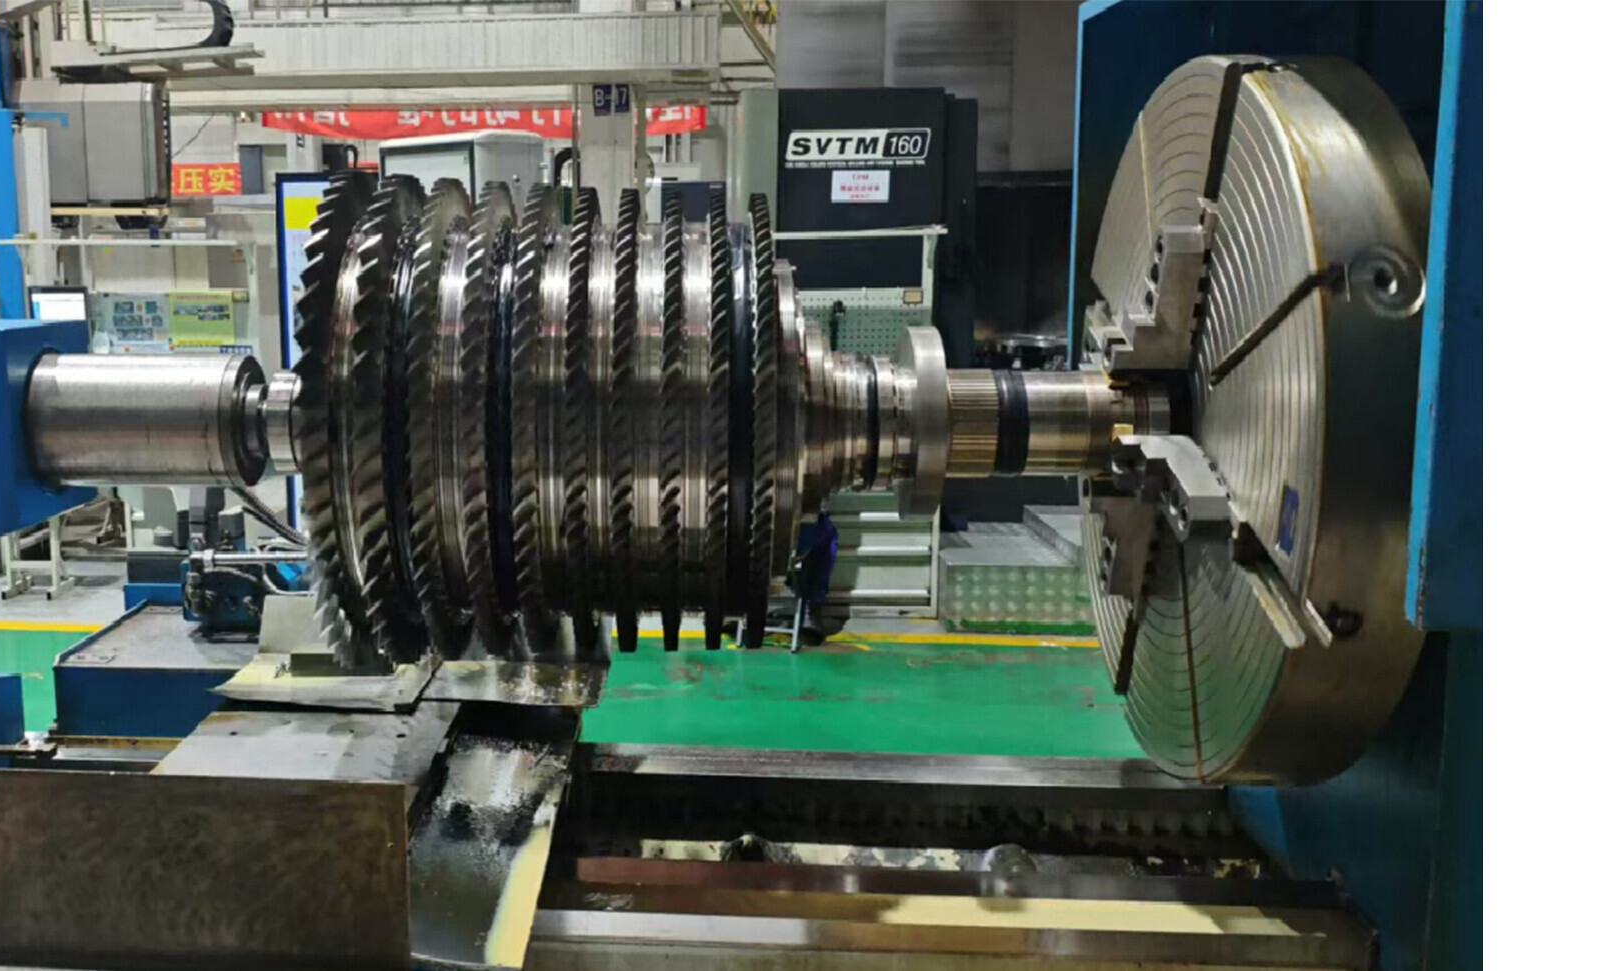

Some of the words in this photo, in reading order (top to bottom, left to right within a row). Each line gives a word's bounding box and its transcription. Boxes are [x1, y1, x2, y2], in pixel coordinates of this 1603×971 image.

[790, 137, 880, 156] SVTM
[889, 135, 922, 154] 160
[172, 167, 235, 193] 压实
